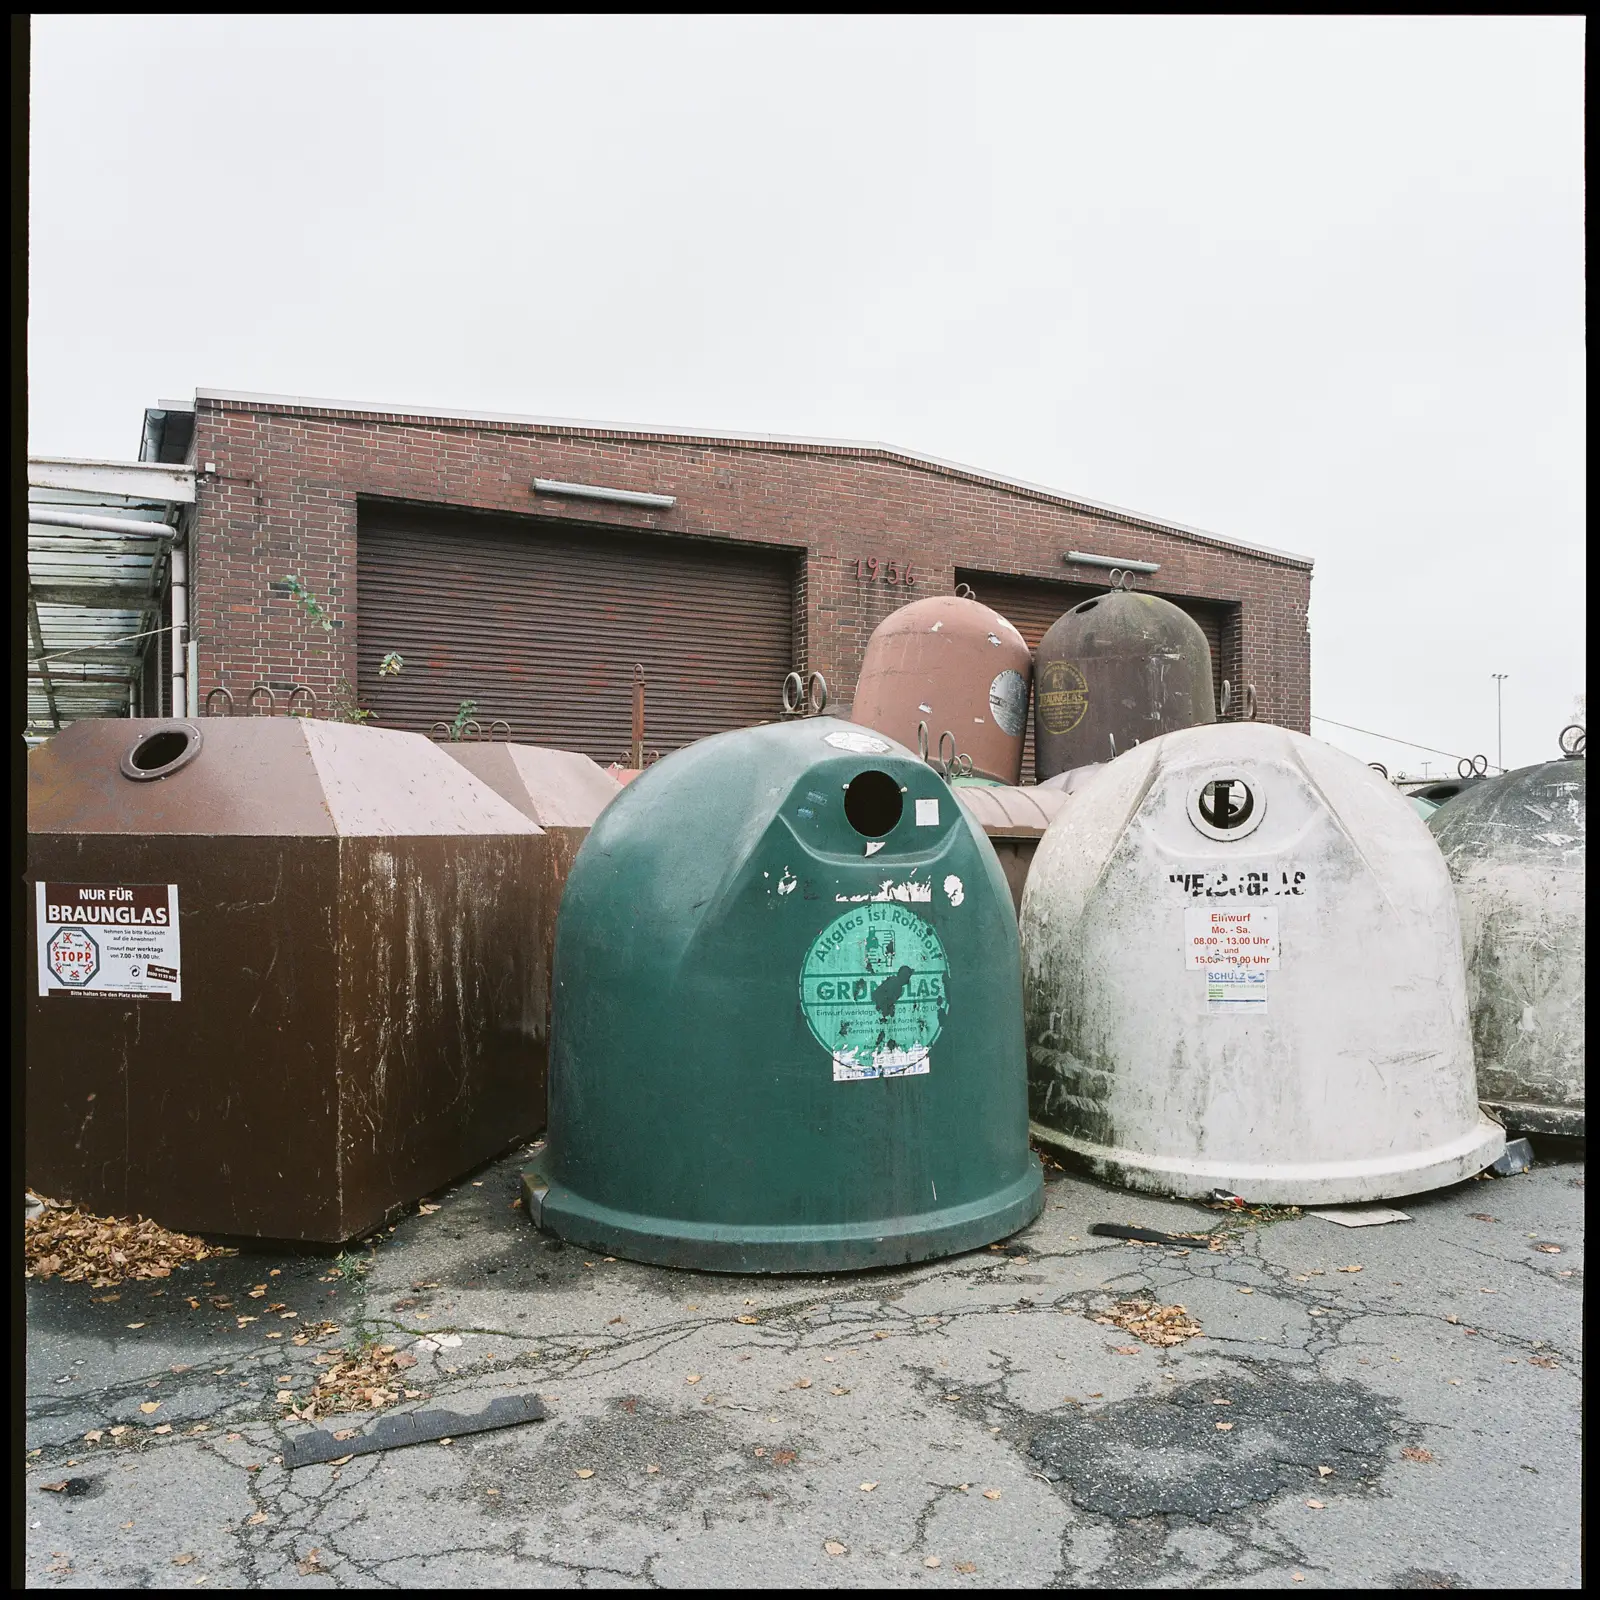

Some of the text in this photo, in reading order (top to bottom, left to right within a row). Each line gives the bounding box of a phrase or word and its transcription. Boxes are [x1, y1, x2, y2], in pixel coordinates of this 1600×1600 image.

[850, 555, 916, 586] 1956
[79, 887, 133, 901] NUR FÜR
[48, 905, 167, 924] BRAUNGLAS
[1211, 913, 1251, 922] Einwurf
[815, 915, 863, 962] Altglas
[868, 909, 886, 922] ist
[1236, 926, 1250, 934] Sa.
[1194, 937, 1218, 945] 08.00
[1226, 937, 1250, 945] 13.00
[1253, 937, 1270, 945] Uhr
[55, 951, 91, 962] STOPP
